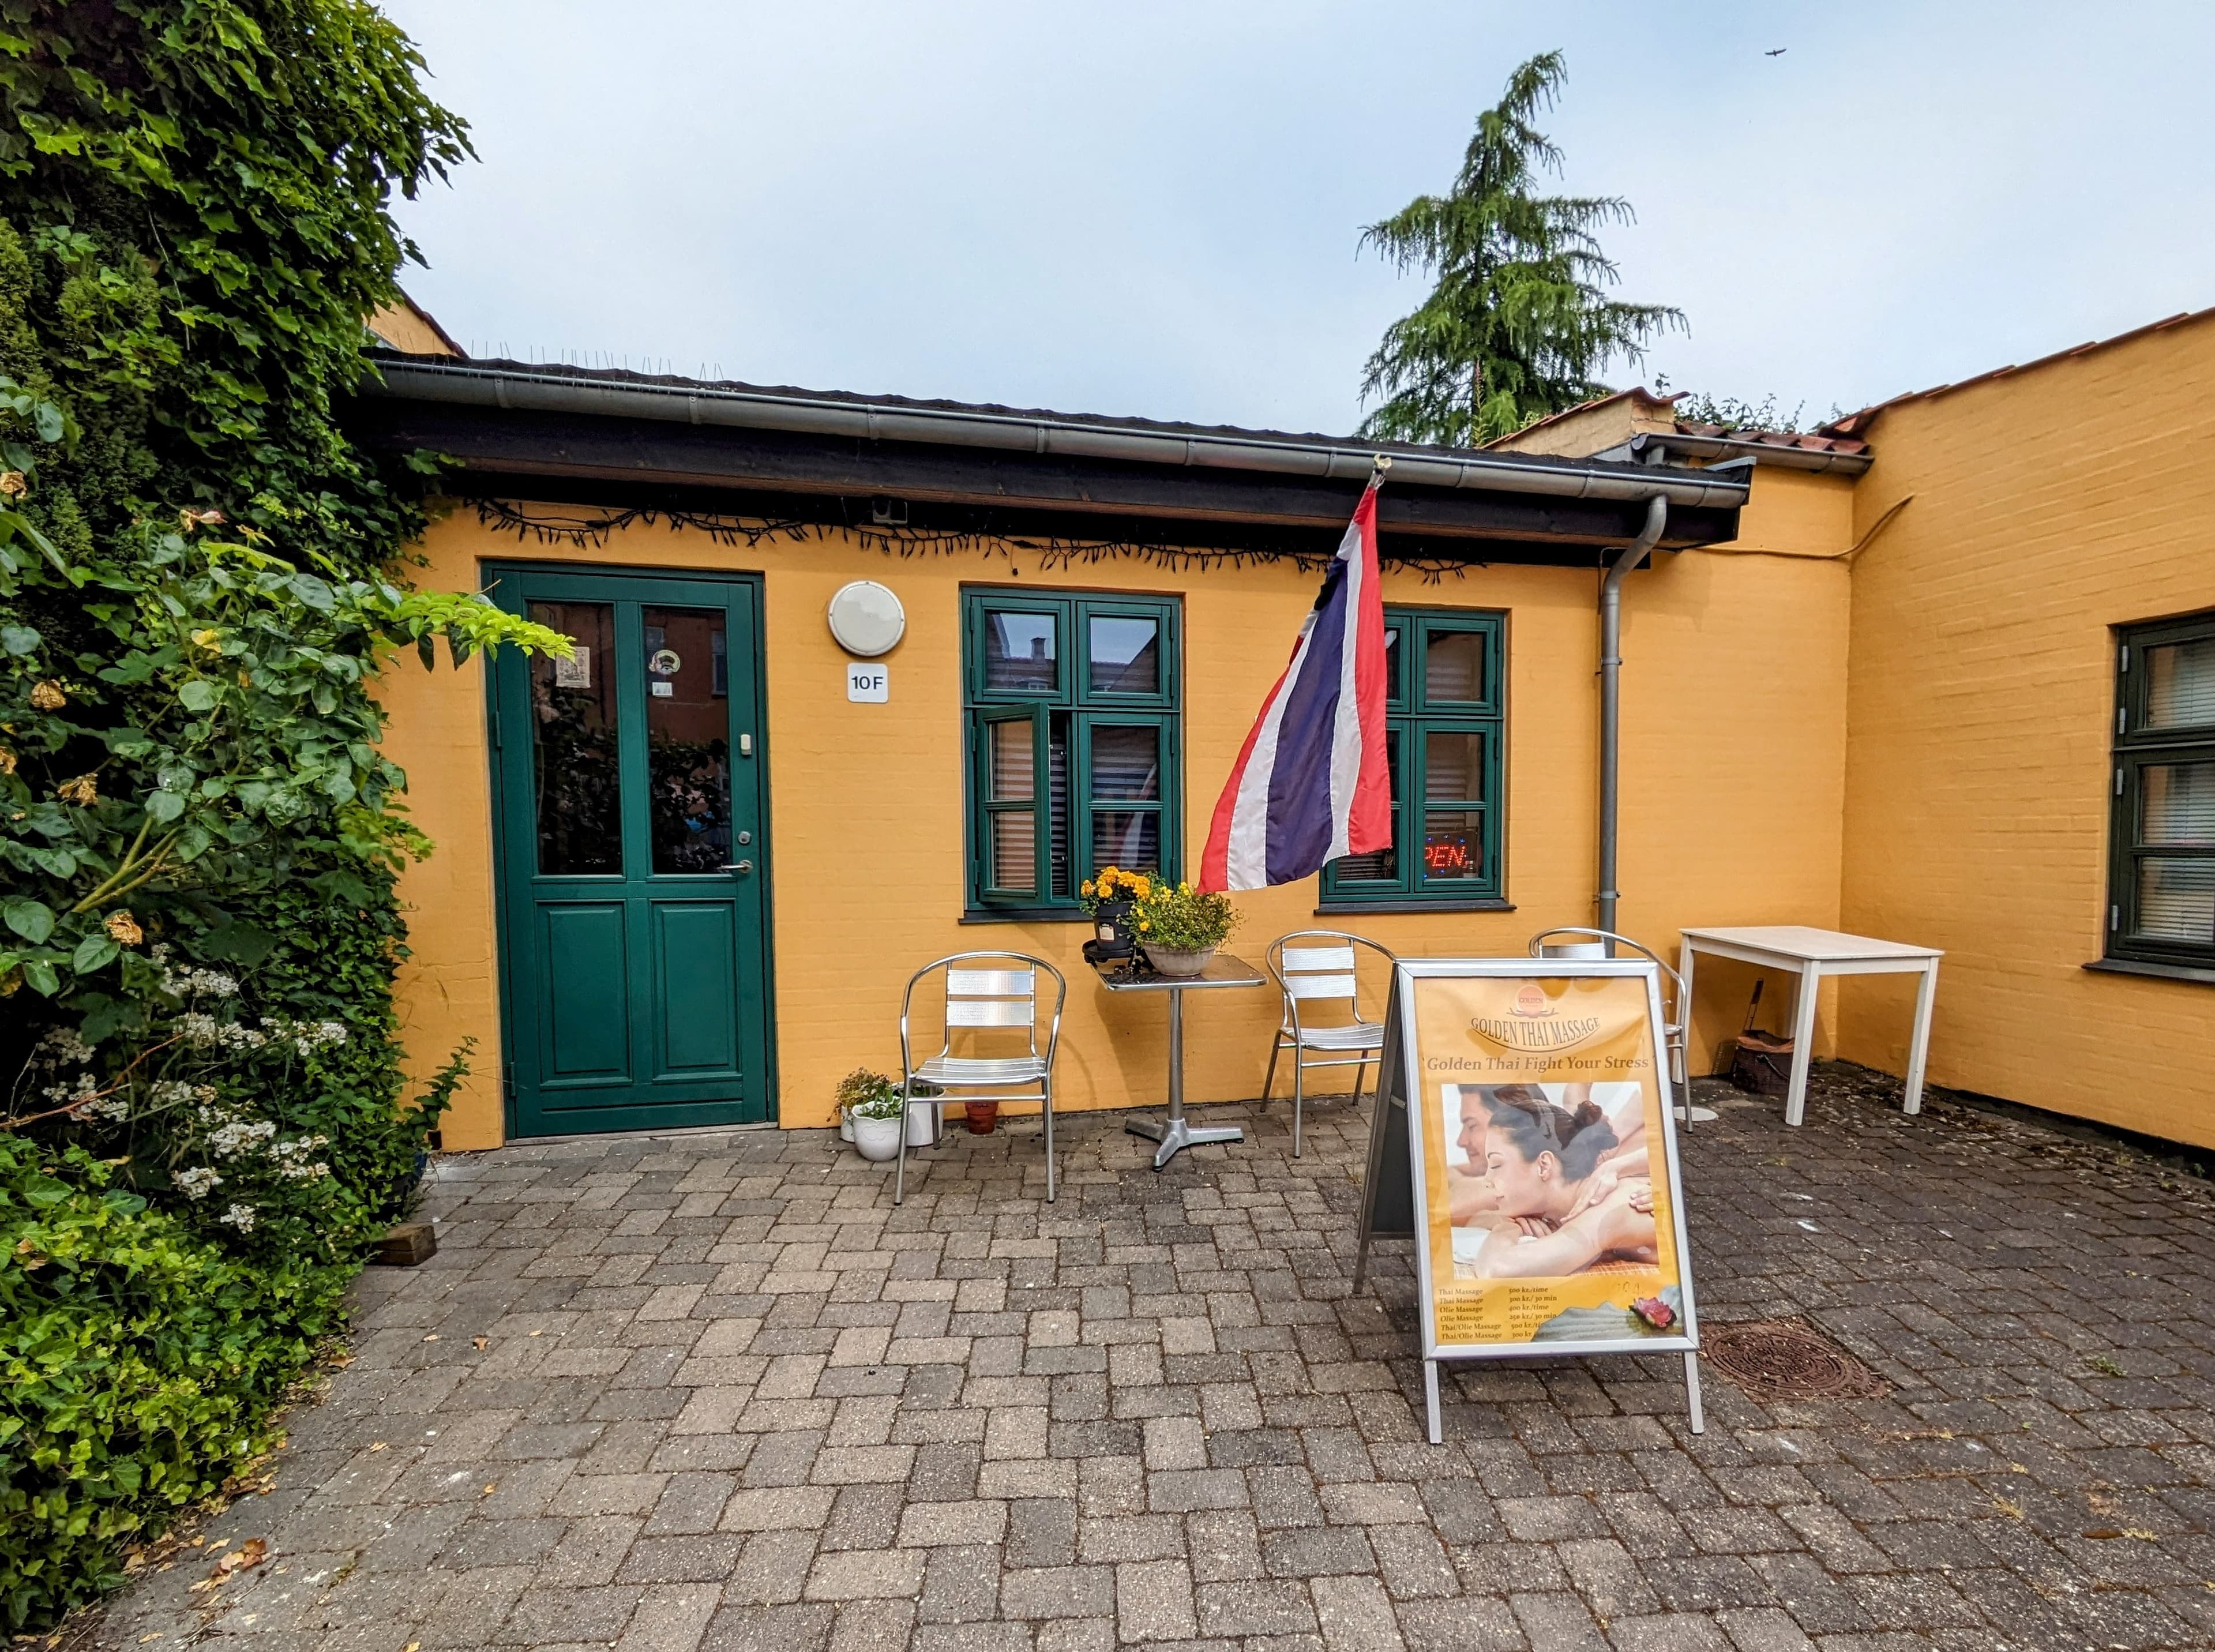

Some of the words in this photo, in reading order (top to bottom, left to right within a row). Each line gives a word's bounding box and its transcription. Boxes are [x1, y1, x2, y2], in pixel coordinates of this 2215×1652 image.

[1425, 846, 1466, 866] PEN
[1471, 1018, 1518, 1045] GOLDEN
[1519, 1022, 1550, 1046] THAI
[1550, 1018, 1600, 1045] MASSAGE
[1427, 1057, 1481, 1071] Golden
[1486, 1057, 1520, 1070] Thai
[1525, 1057, 1563, 1073] Fight
[1567, 1057, 1601, 1069] Your
[1605, 1056, 1649, 1069] Stress
